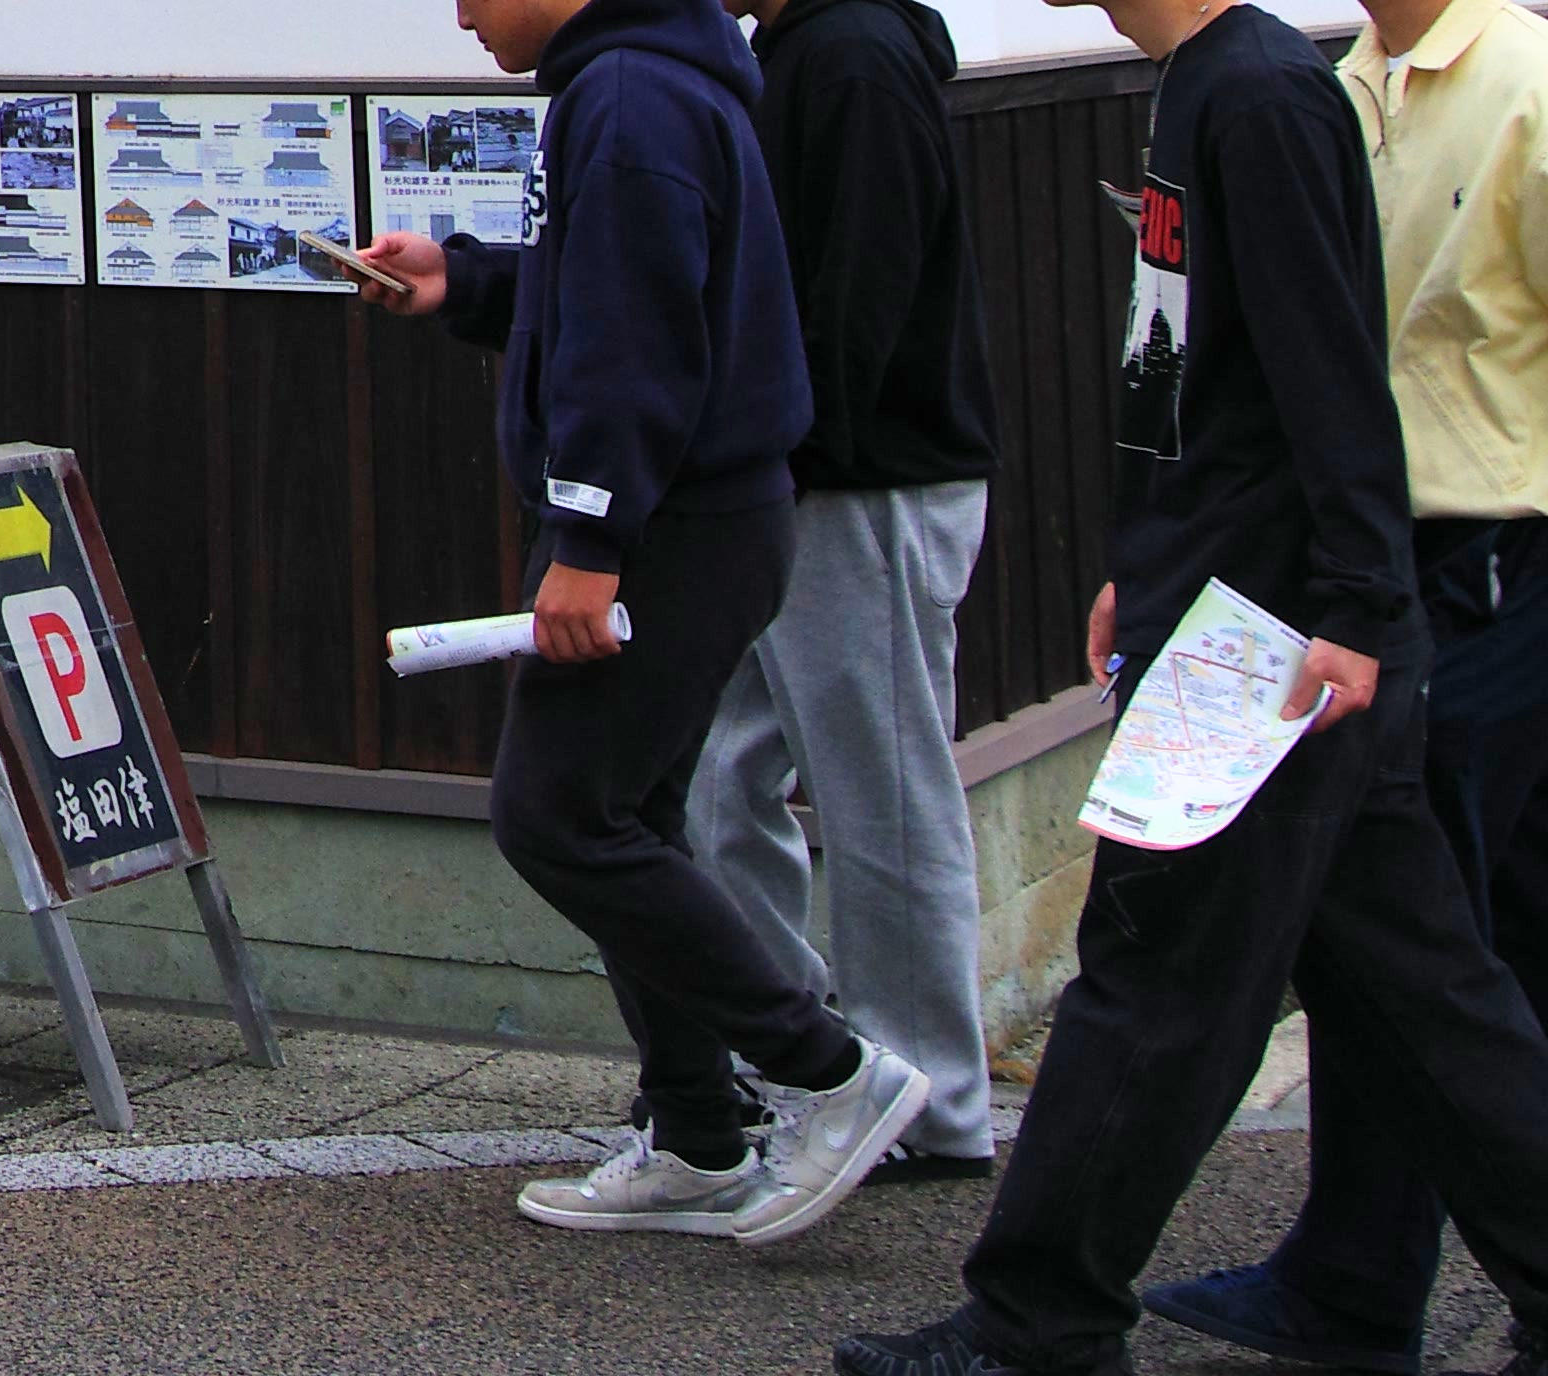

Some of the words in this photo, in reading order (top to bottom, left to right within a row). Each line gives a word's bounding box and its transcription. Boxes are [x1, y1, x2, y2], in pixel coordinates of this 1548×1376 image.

[28, 612, 86, 742] P
[55, 754, 156, 843] 塩田津
